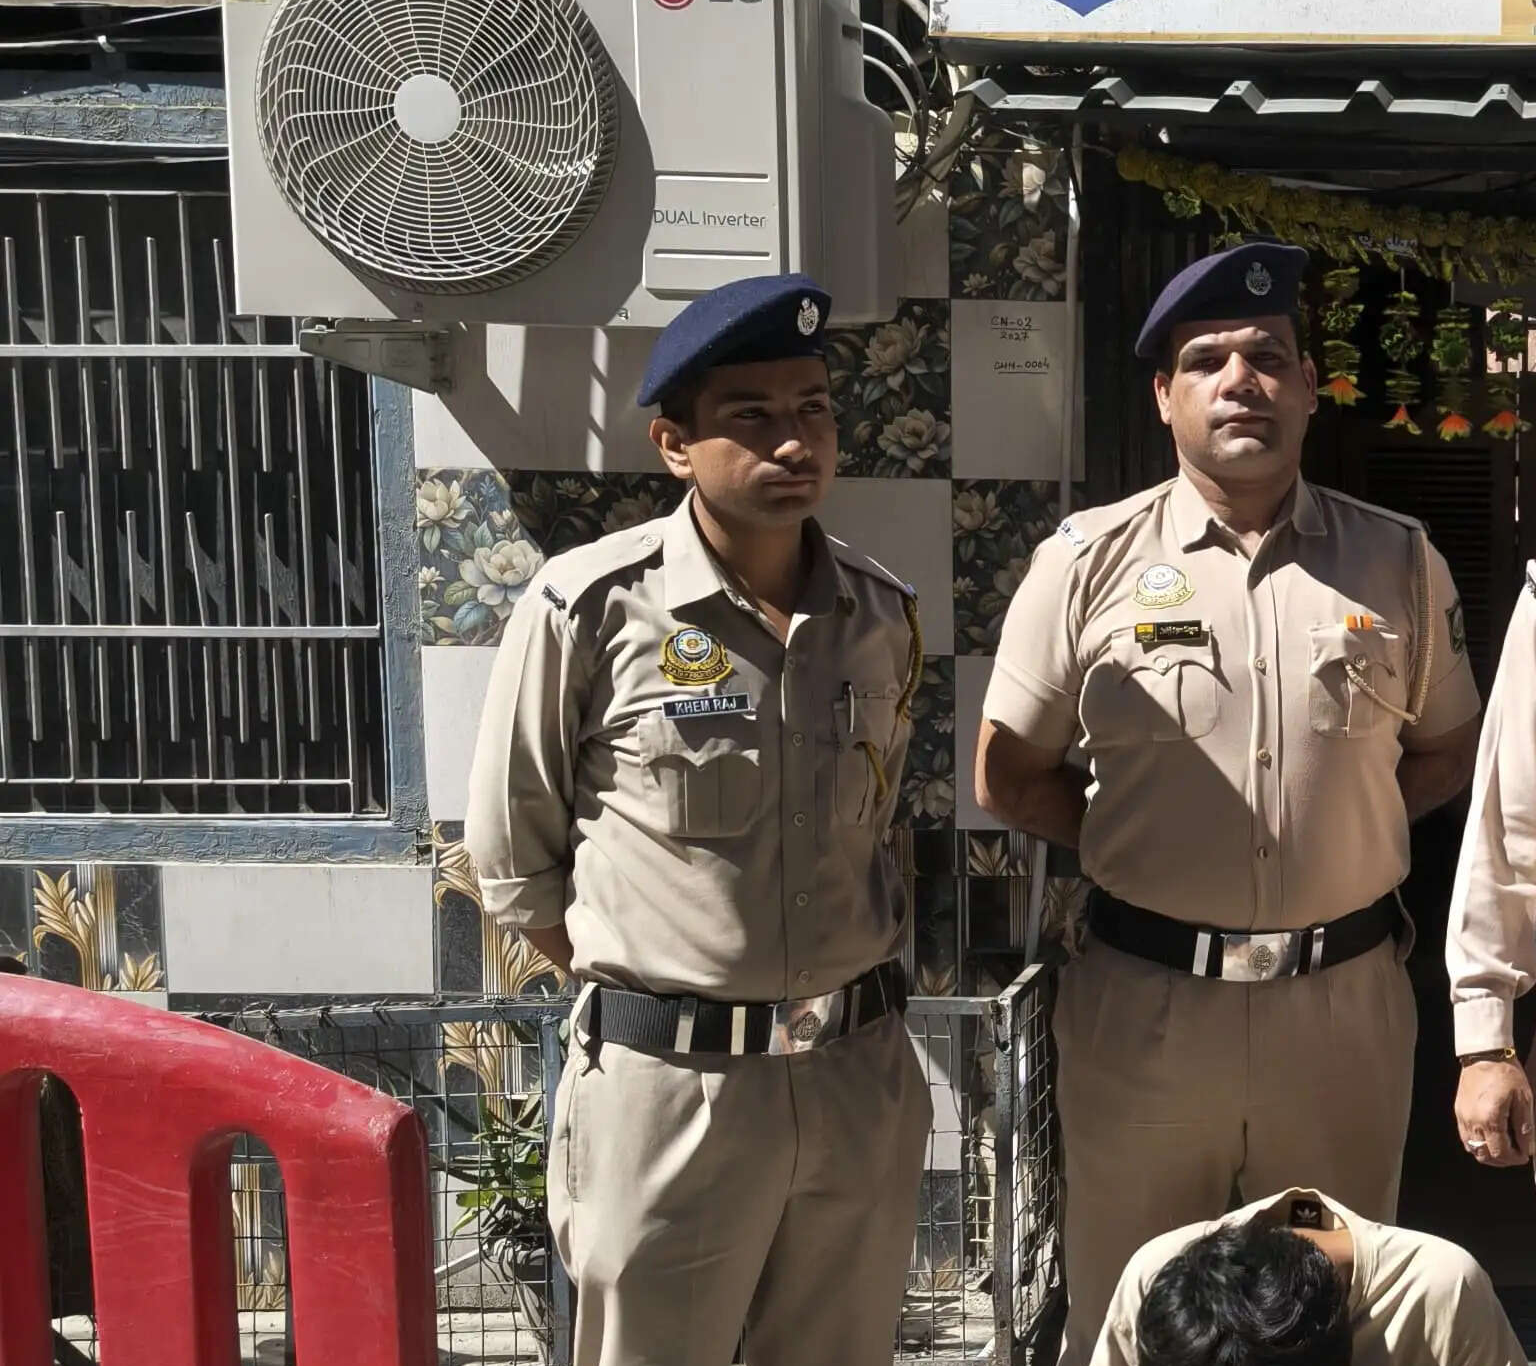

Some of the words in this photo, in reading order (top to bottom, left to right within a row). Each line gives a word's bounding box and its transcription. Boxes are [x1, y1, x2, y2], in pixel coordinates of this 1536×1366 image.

[653, 209, 699, 225] DUAL
[702, 211, 766, 228] Inverter
[675, 701, 711, 715] KHEM
[713, 699, 737, 711] RAJ
